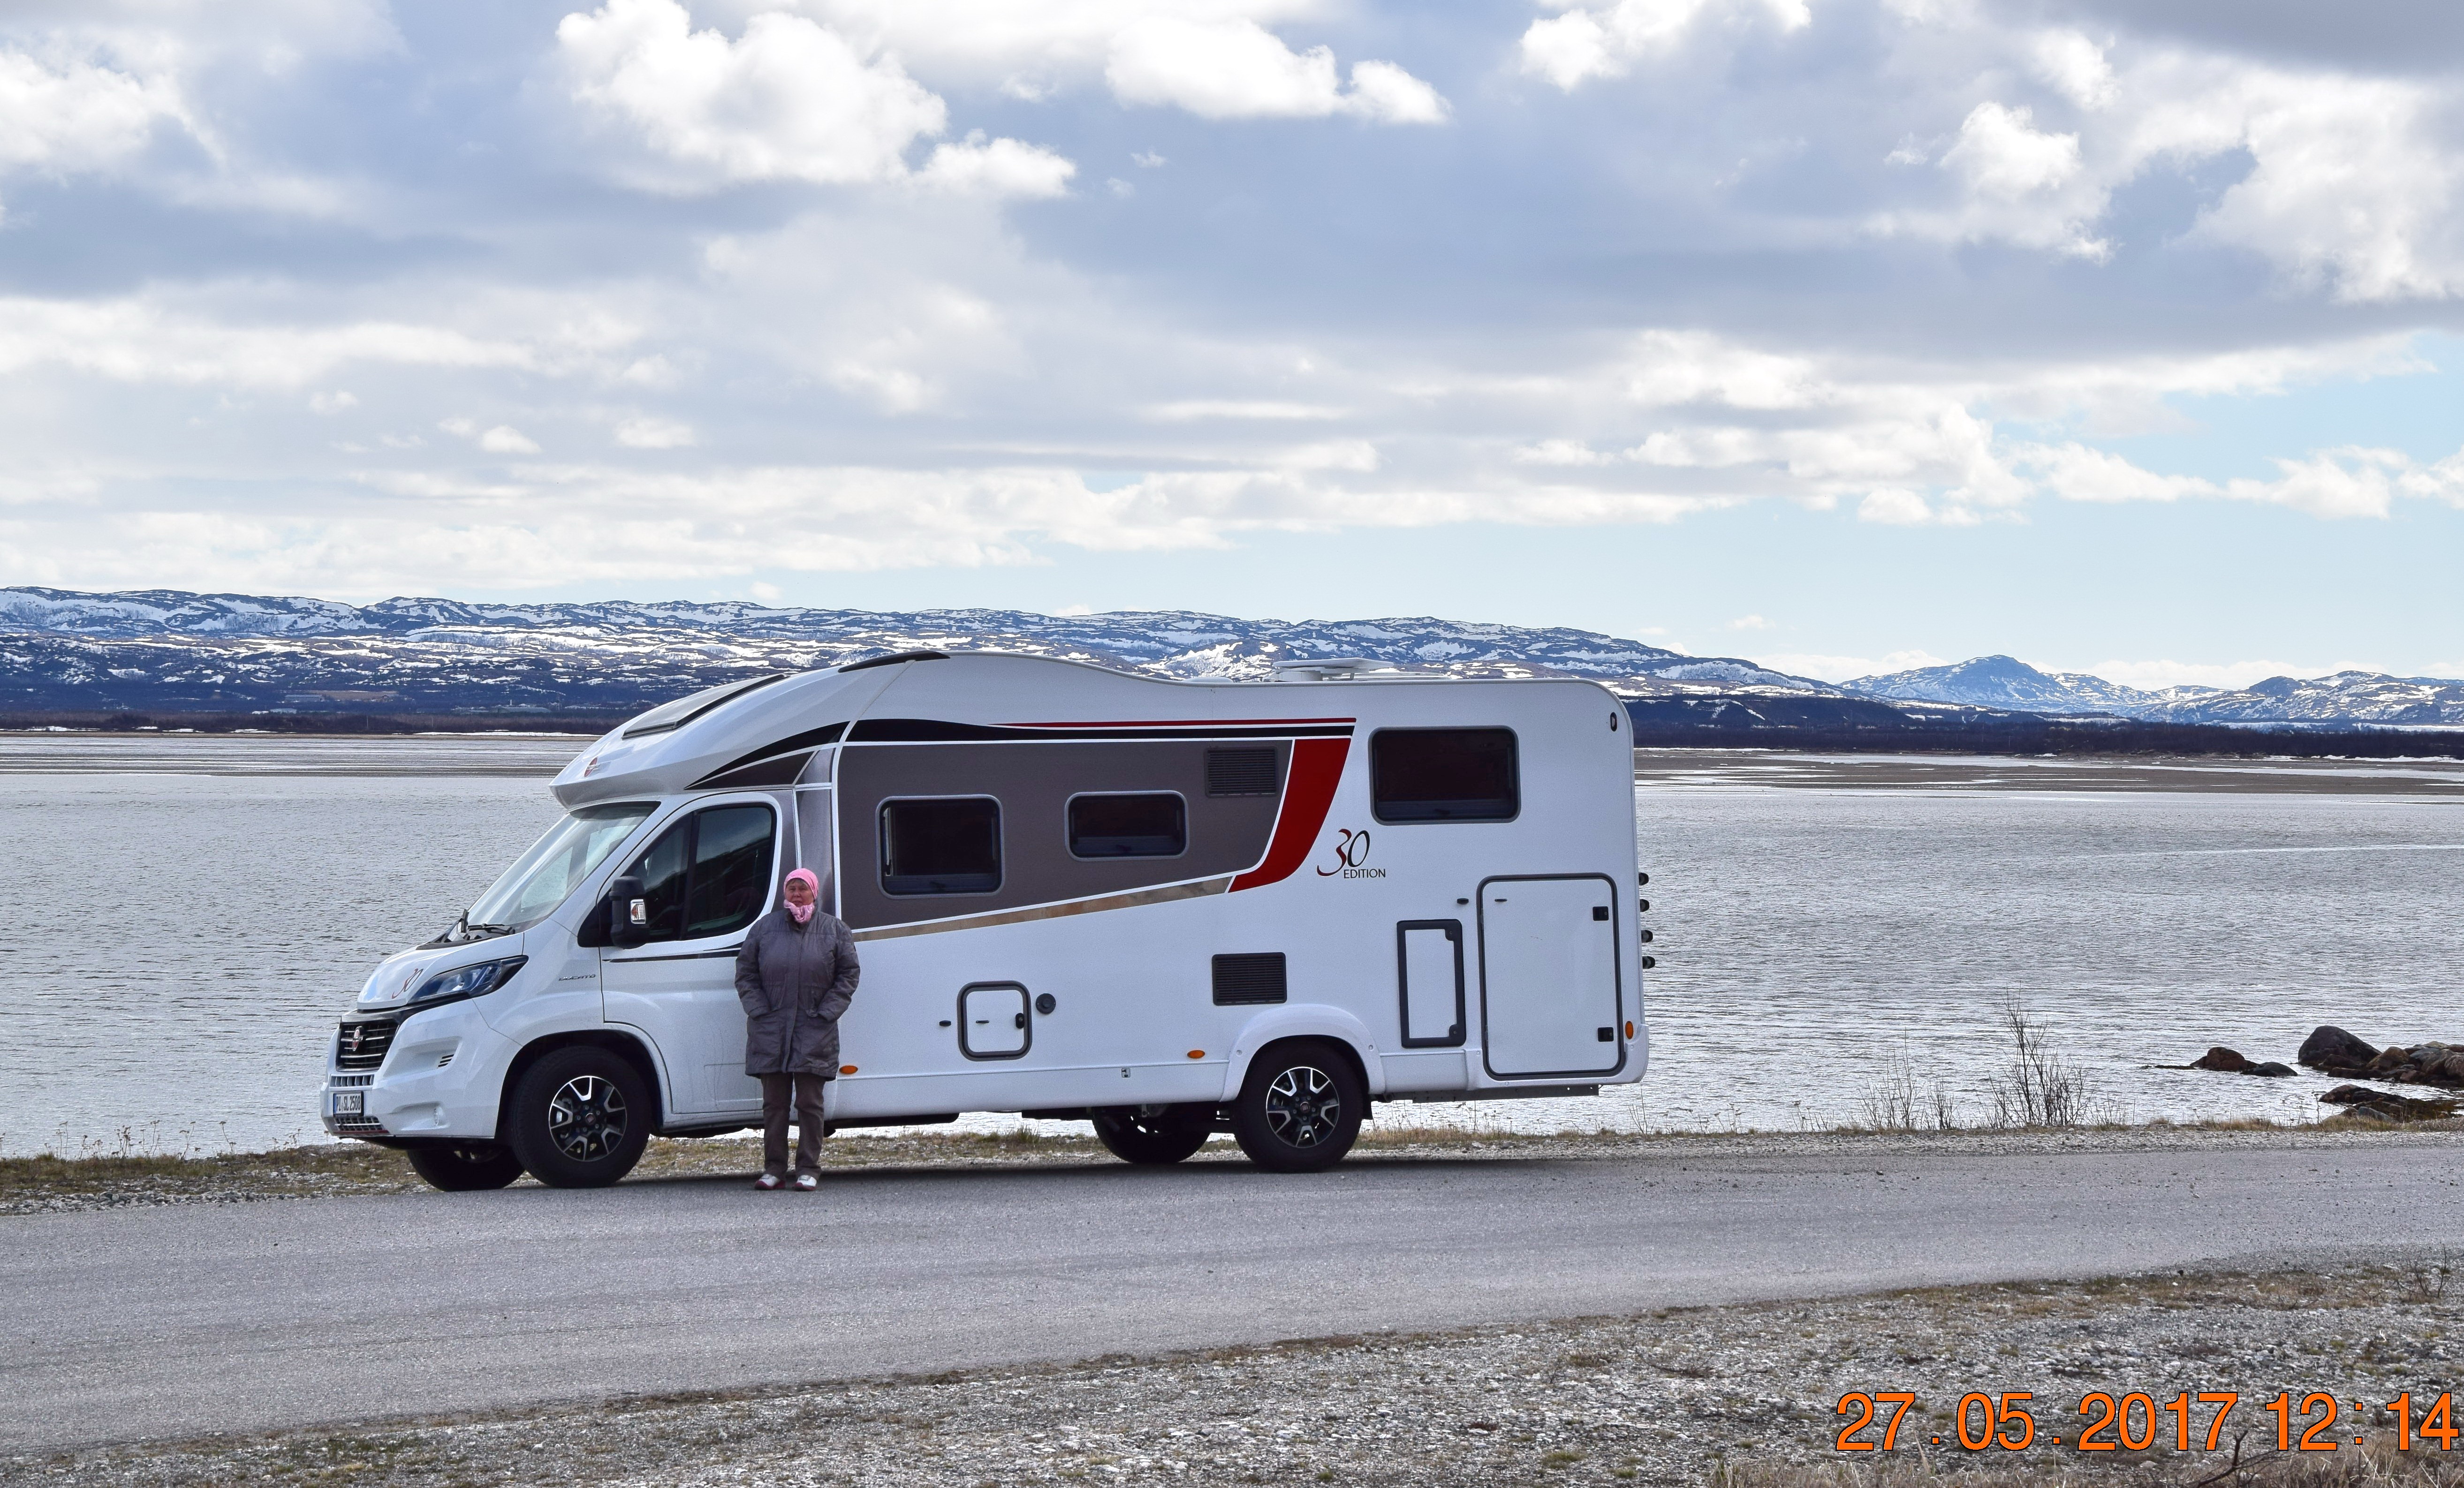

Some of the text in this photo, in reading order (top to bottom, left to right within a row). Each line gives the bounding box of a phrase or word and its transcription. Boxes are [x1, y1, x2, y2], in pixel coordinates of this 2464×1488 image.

[1317, 829, 1370, 876] 30
[1343, 869, 1386, 879] EDITION
[392, 968, 424, 999] 30
[336, 1096, 341, 1111] PI
[343, 1095, 349, 1111] SL
